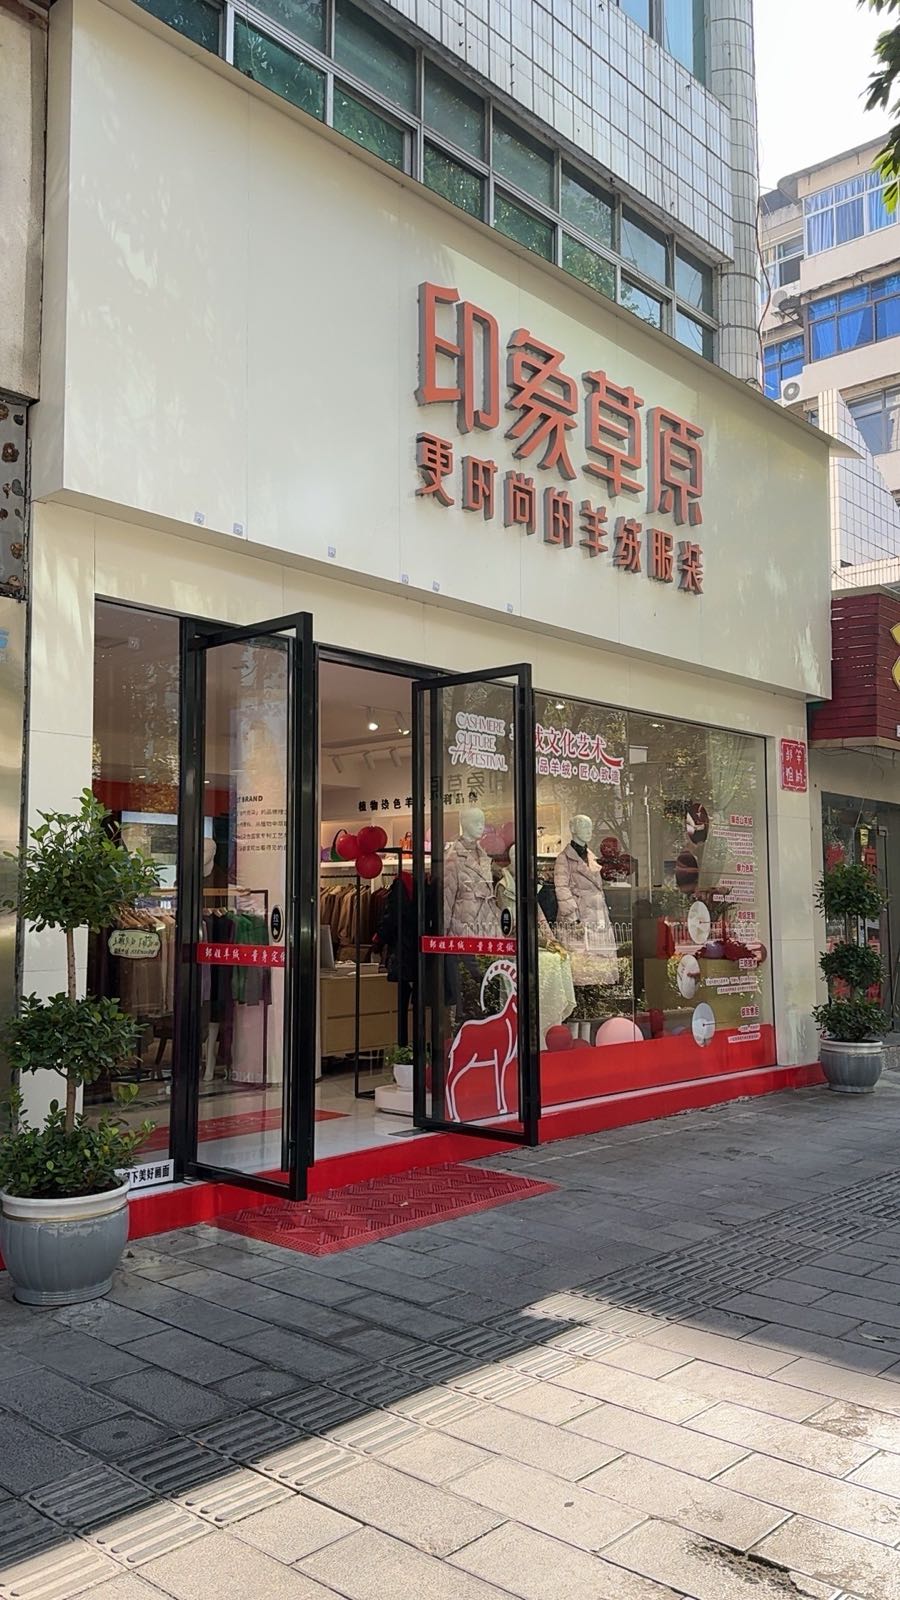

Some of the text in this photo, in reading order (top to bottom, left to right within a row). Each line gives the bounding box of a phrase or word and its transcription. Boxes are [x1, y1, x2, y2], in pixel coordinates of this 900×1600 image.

[415, 281, 704, 526] 印象草原
[416, 432, 704, 594] 更时尚的羊绒服装
